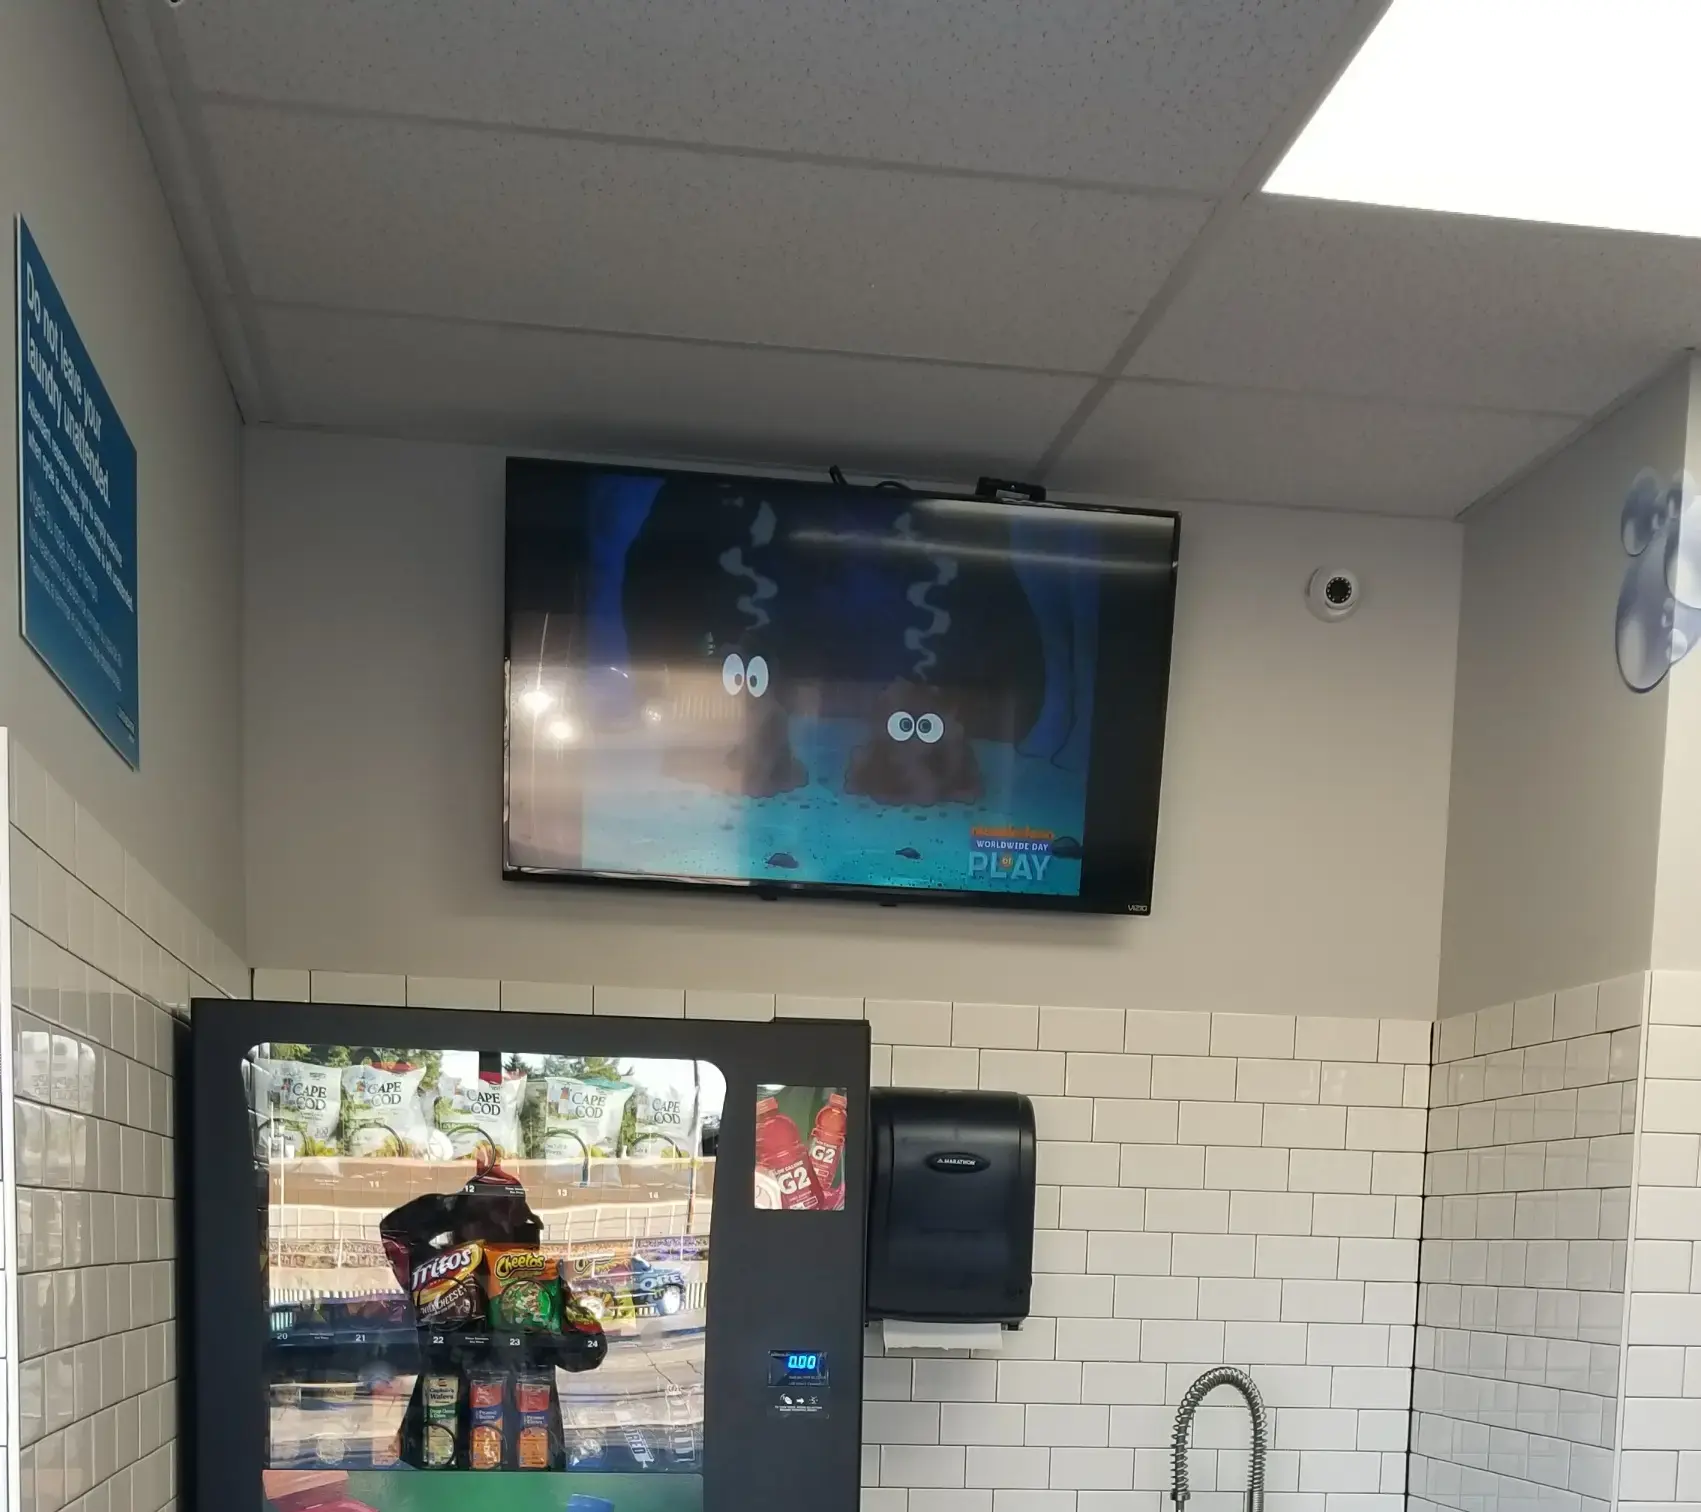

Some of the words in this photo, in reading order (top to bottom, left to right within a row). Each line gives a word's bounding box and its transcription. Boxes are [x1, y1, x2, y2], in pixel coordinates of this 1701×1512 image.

[27, 261, 41, 324] Do
[43, 306, 59, 362] not
[60, 329, 83, 405] leave
[84, 387, 102, 441] your
[27, 319, 62, 428] laundry
[64, 401, 110, 508] unattended.
[976, 840, 1029, 850] WORLDWIDE
[1032, 843, 1049, 851] DAY
[969, 851, 1052, 880] PLAY
[293, 1083, 327, 1098] CAPE
[368, 1082, 402, 1094] CAPE
[372, 1094, 402, 1106] COD
[466, 1089, 500, 1103] CAPE
[572, 1092, 606, 1106] CAPE
[296, 1097, 326, 1111] COD
[471, 1102, 500, 1115] COD
[652, 1098, 680, 1112] CAPE
[575, 1106, 603, 1119] COD
[654, 1112, 680, 1124] COD
[812, 1145, 836, 1164] G2
[777, 1166, 812, 1194] G2
[465, 1185, 475, 1193] 12
[496, 1254, 546, 1277] Cheetos
[355, 1334, 366, 1342] 21
[432, 1336, 444, 1344] 22
[509, 1338, 521, 1346] 23
